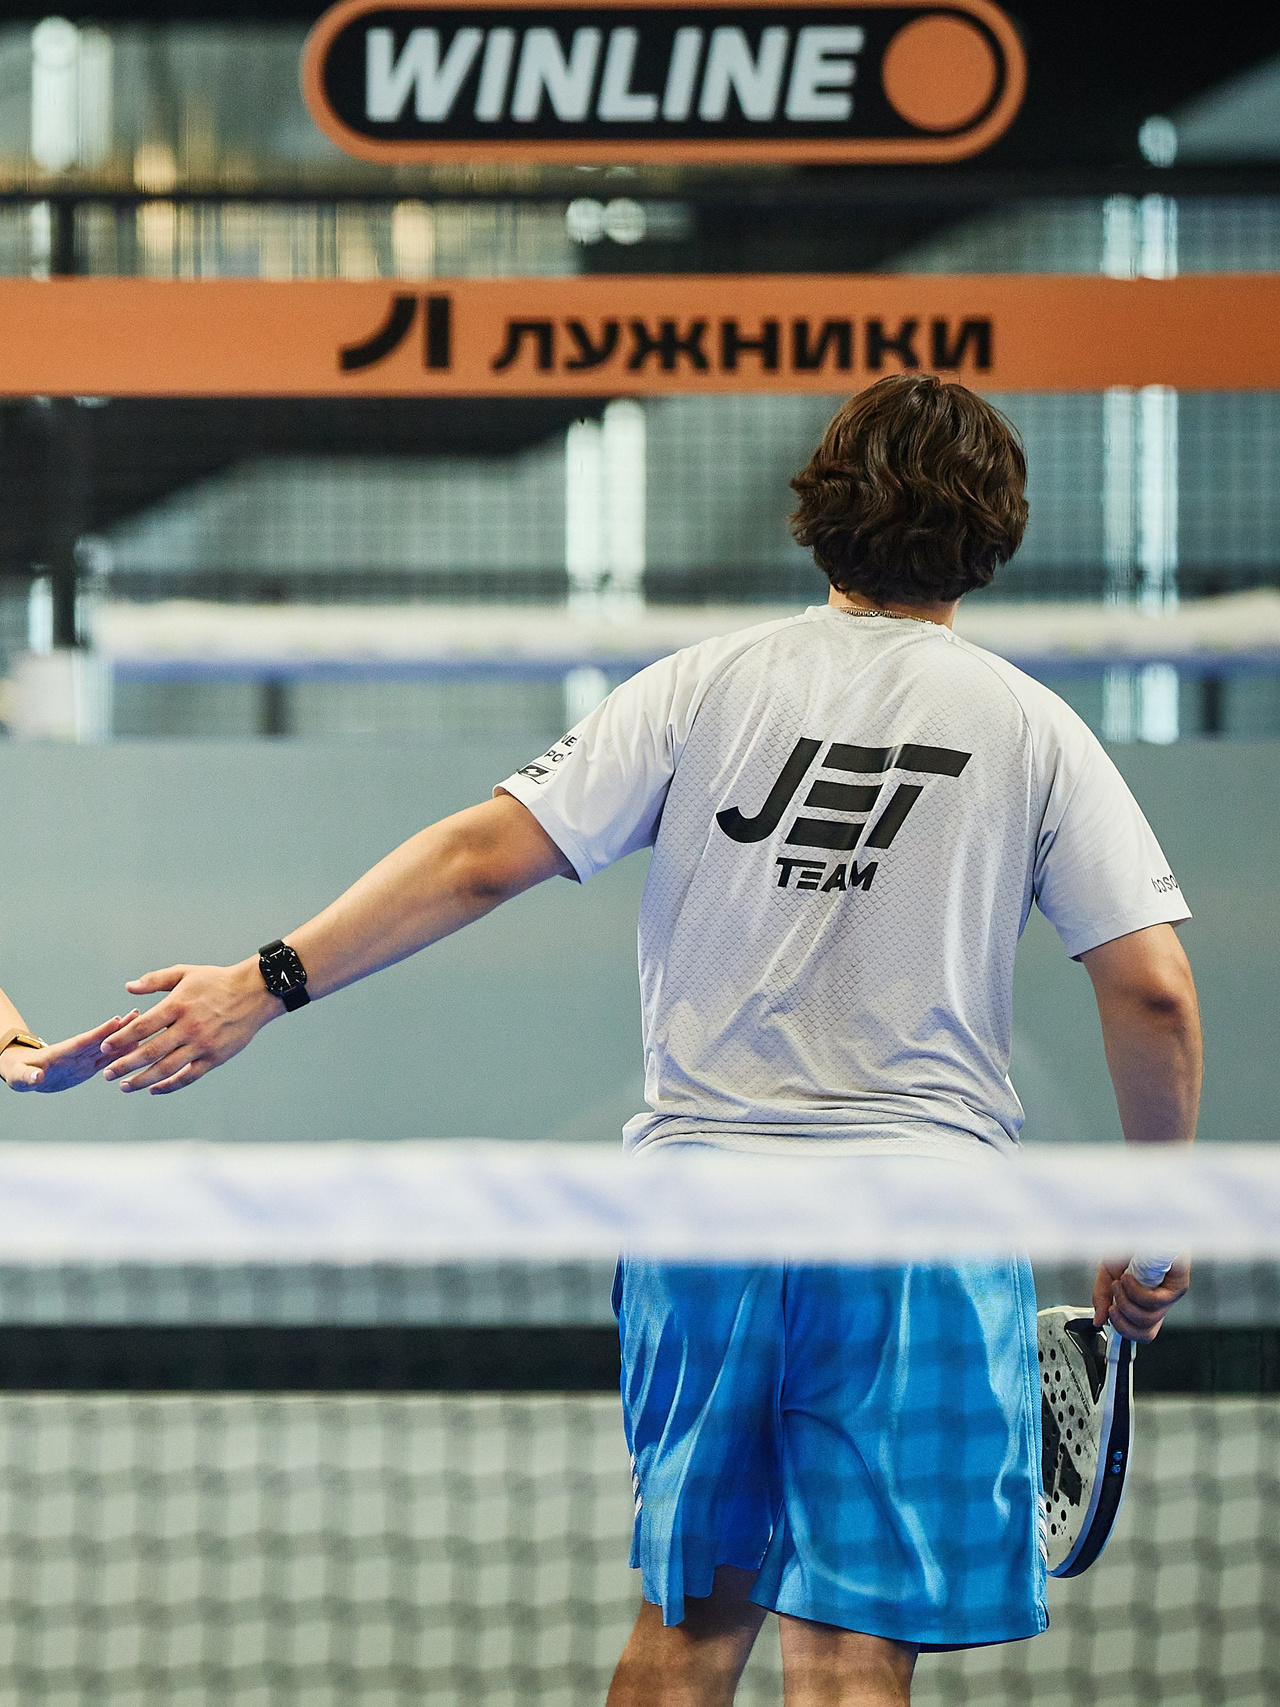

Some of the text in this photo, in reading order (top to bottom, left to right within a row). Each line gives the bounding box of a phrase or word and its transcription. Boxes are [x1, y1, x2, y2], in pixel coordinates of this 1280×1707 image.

[367, 28, 863, 122] WINLINE
[491, 314, 995, 375] ЛУЖНИКИ
[715, 736, 973, 851] JET
[776, 856, 879, 893] TEAM
